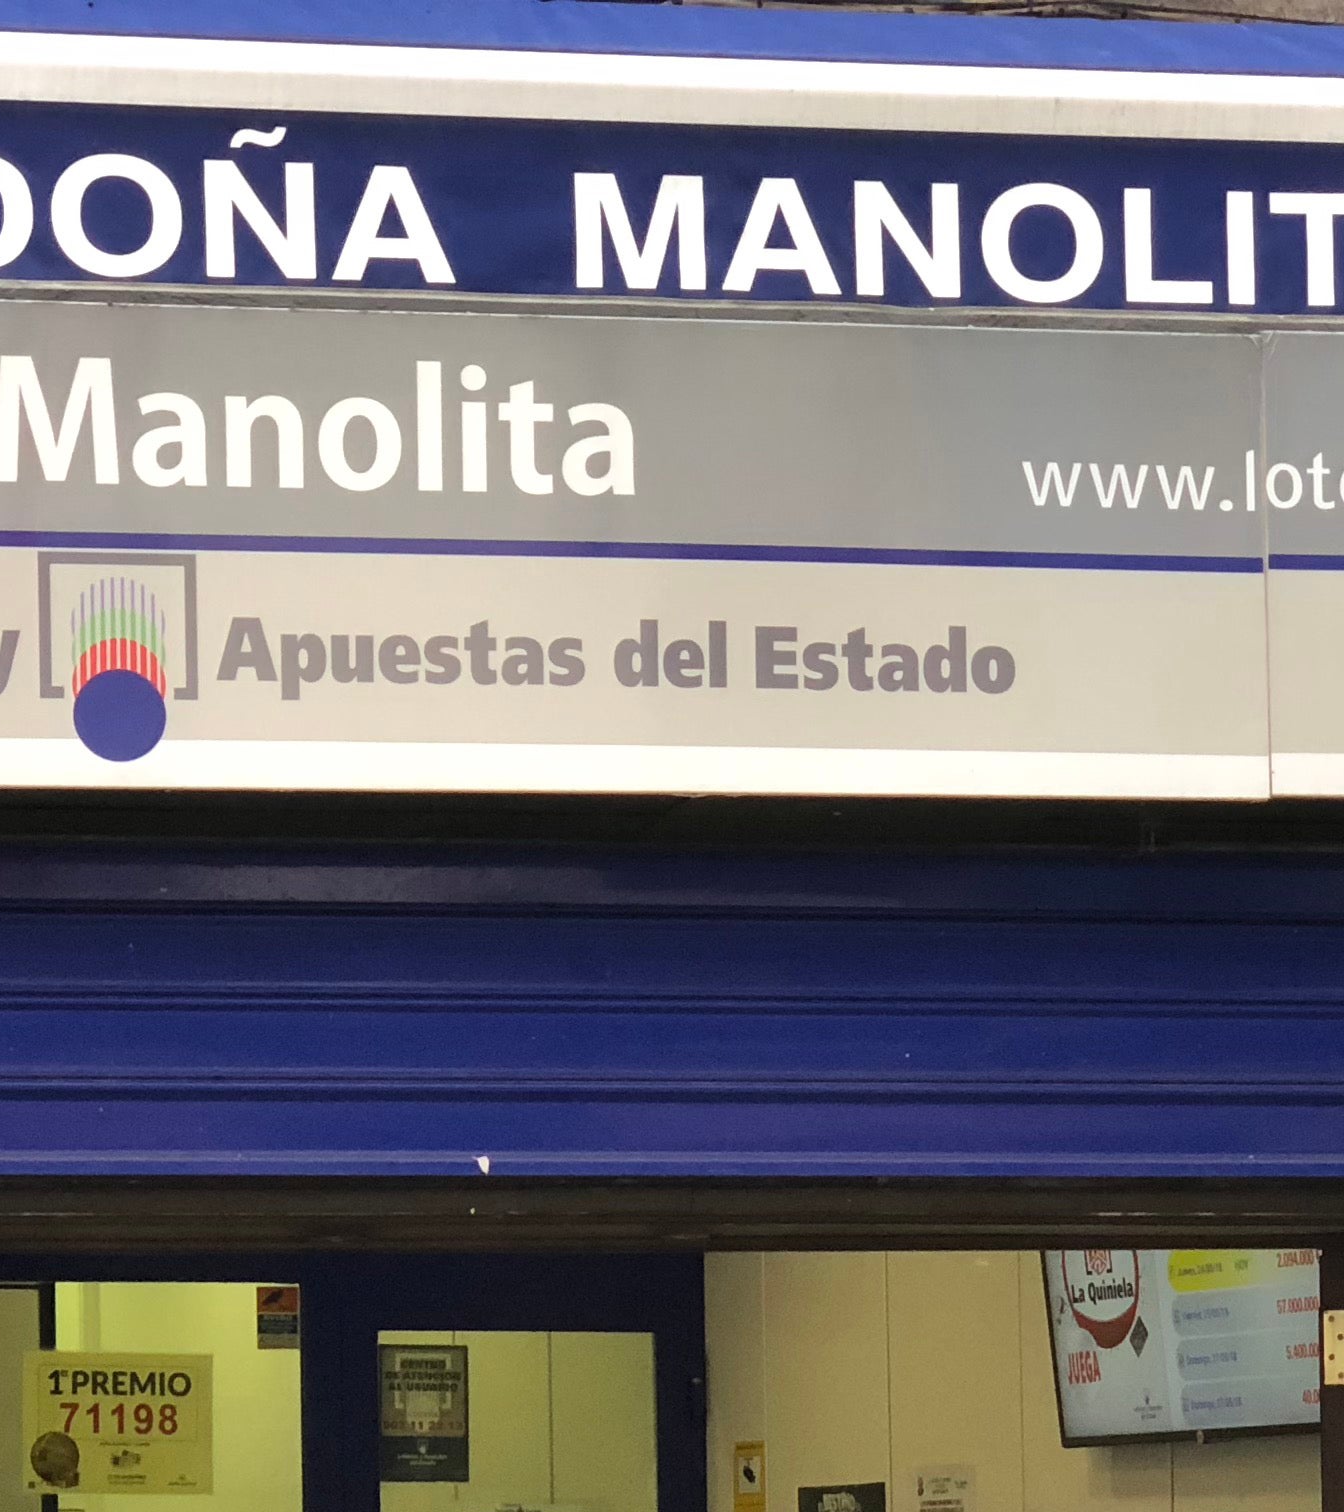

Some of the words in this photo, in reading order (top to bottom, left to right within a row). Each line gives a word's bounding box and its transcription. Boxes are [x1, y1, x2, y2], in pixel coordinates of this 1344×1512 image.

[216, 616, 586, 700] Apuestas
[613, 619, 728, 689] del
[755, 625, 1017, 695] Estado
[1088, 1278, 1134, 1302] Quiniela
[72, 1370, 193, 1397] PREMIO
[1067, 1350, 1102, 1386] JUEGA
[60, 1403, 179, 1435] 71198
